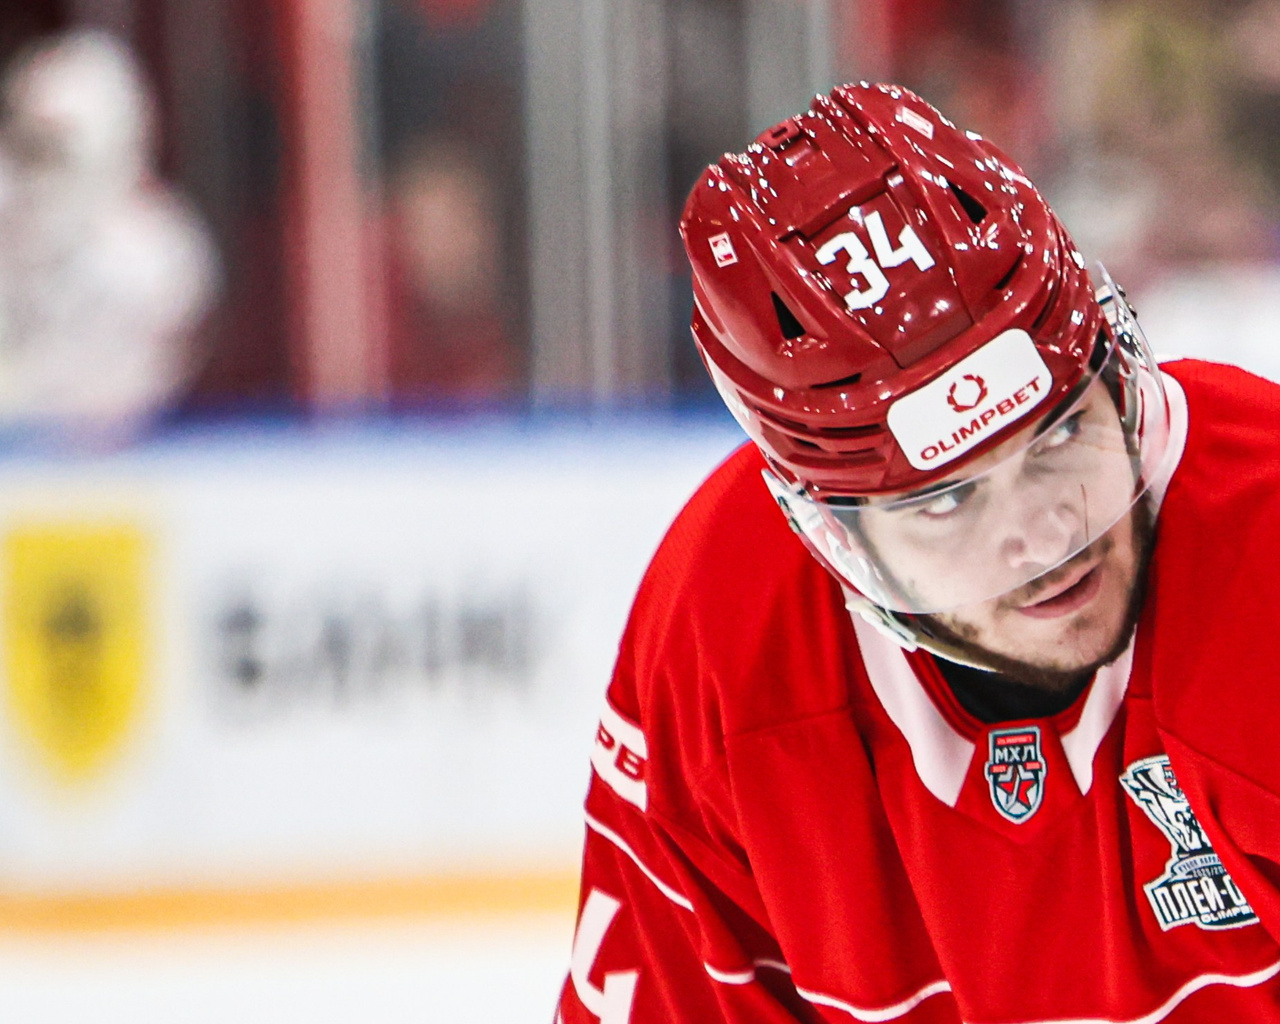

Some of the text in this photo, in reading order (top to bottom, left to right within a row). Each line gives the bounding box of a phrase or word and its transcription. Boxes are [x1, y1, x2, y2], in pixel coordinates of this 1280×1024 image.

[816, 211, 935, 310] 34
[919, 376, 1041, 462] OLIMPBET
[995, 744, 1036, 764] МХЛ
